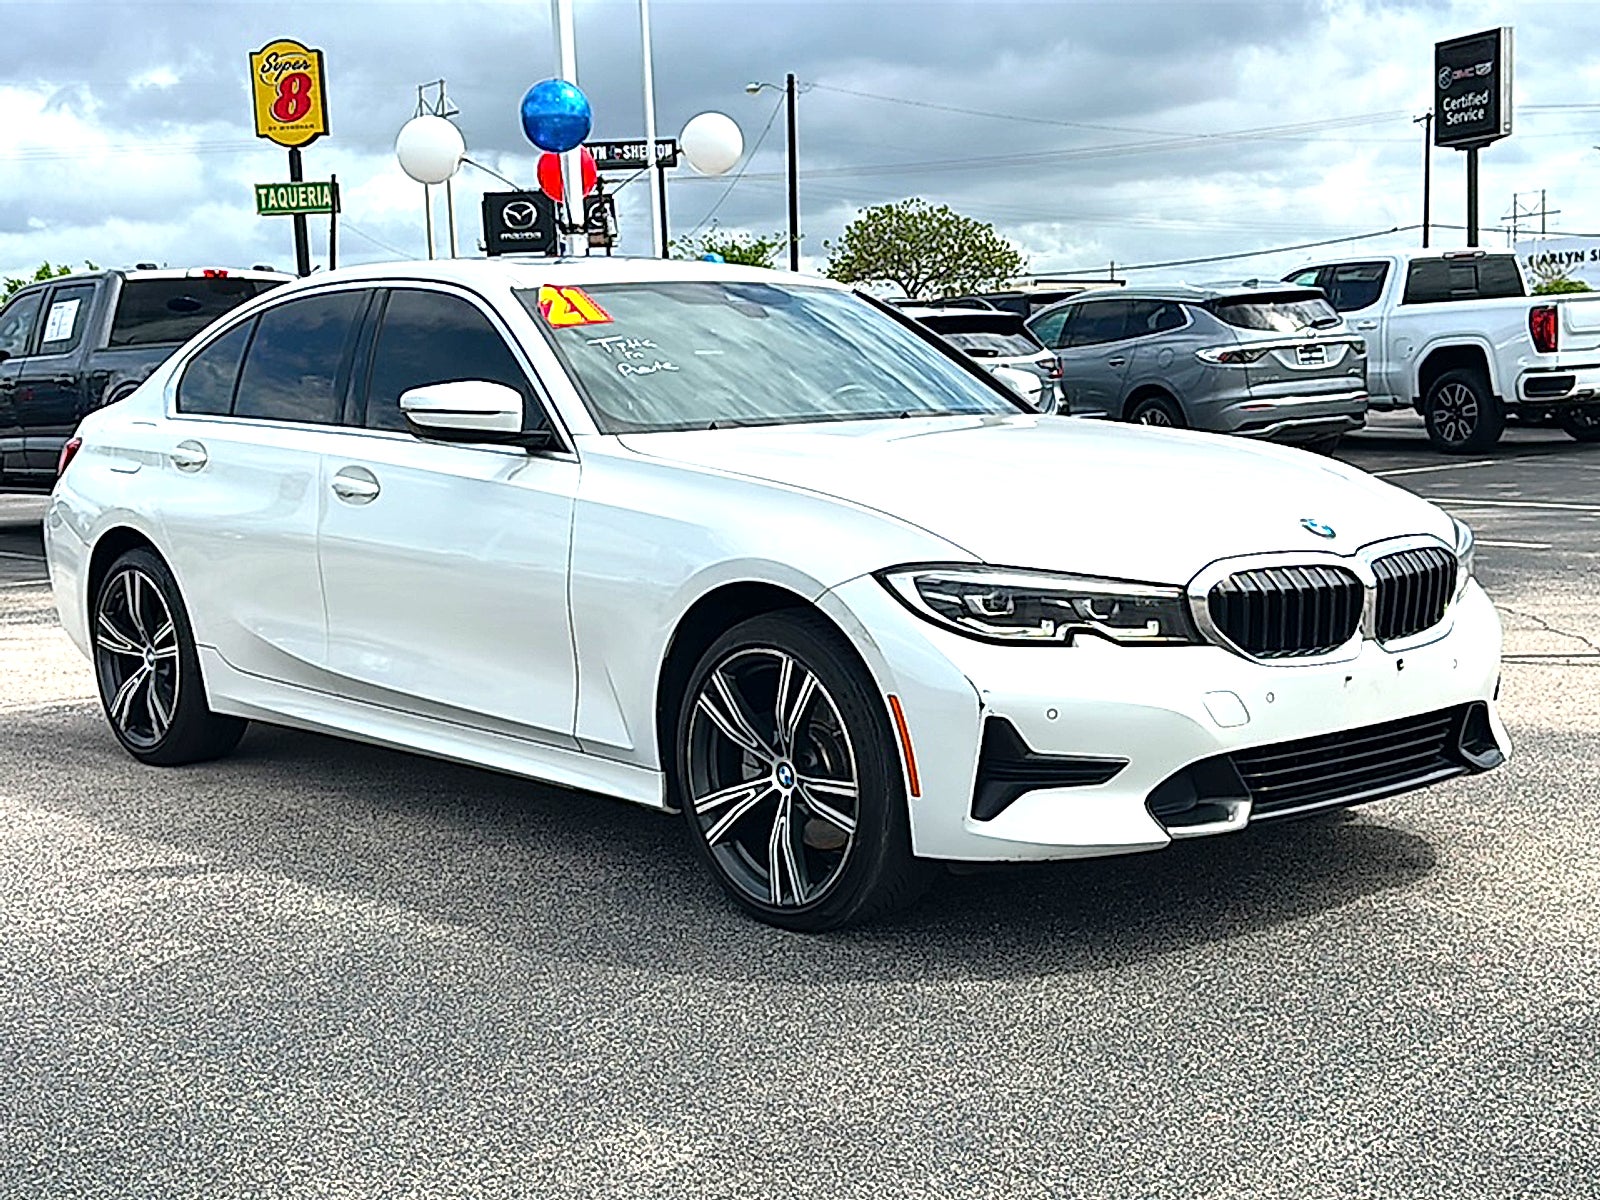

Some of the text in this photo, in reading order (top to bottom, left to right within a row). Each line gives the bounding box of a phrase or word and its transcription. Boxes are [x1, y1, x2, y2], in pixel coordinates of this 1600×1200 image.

[261, 52, 311, 82] Super
[272, 72, 312, 123] 8
[1443, 89, 1490, 111] Certified
[1446, 107, 1485, 126] Service
[623, 143, 673, 160] SHEON
[258, 186, 332, 209] TAQUERIA
[538, 285, 609, 327] 21
